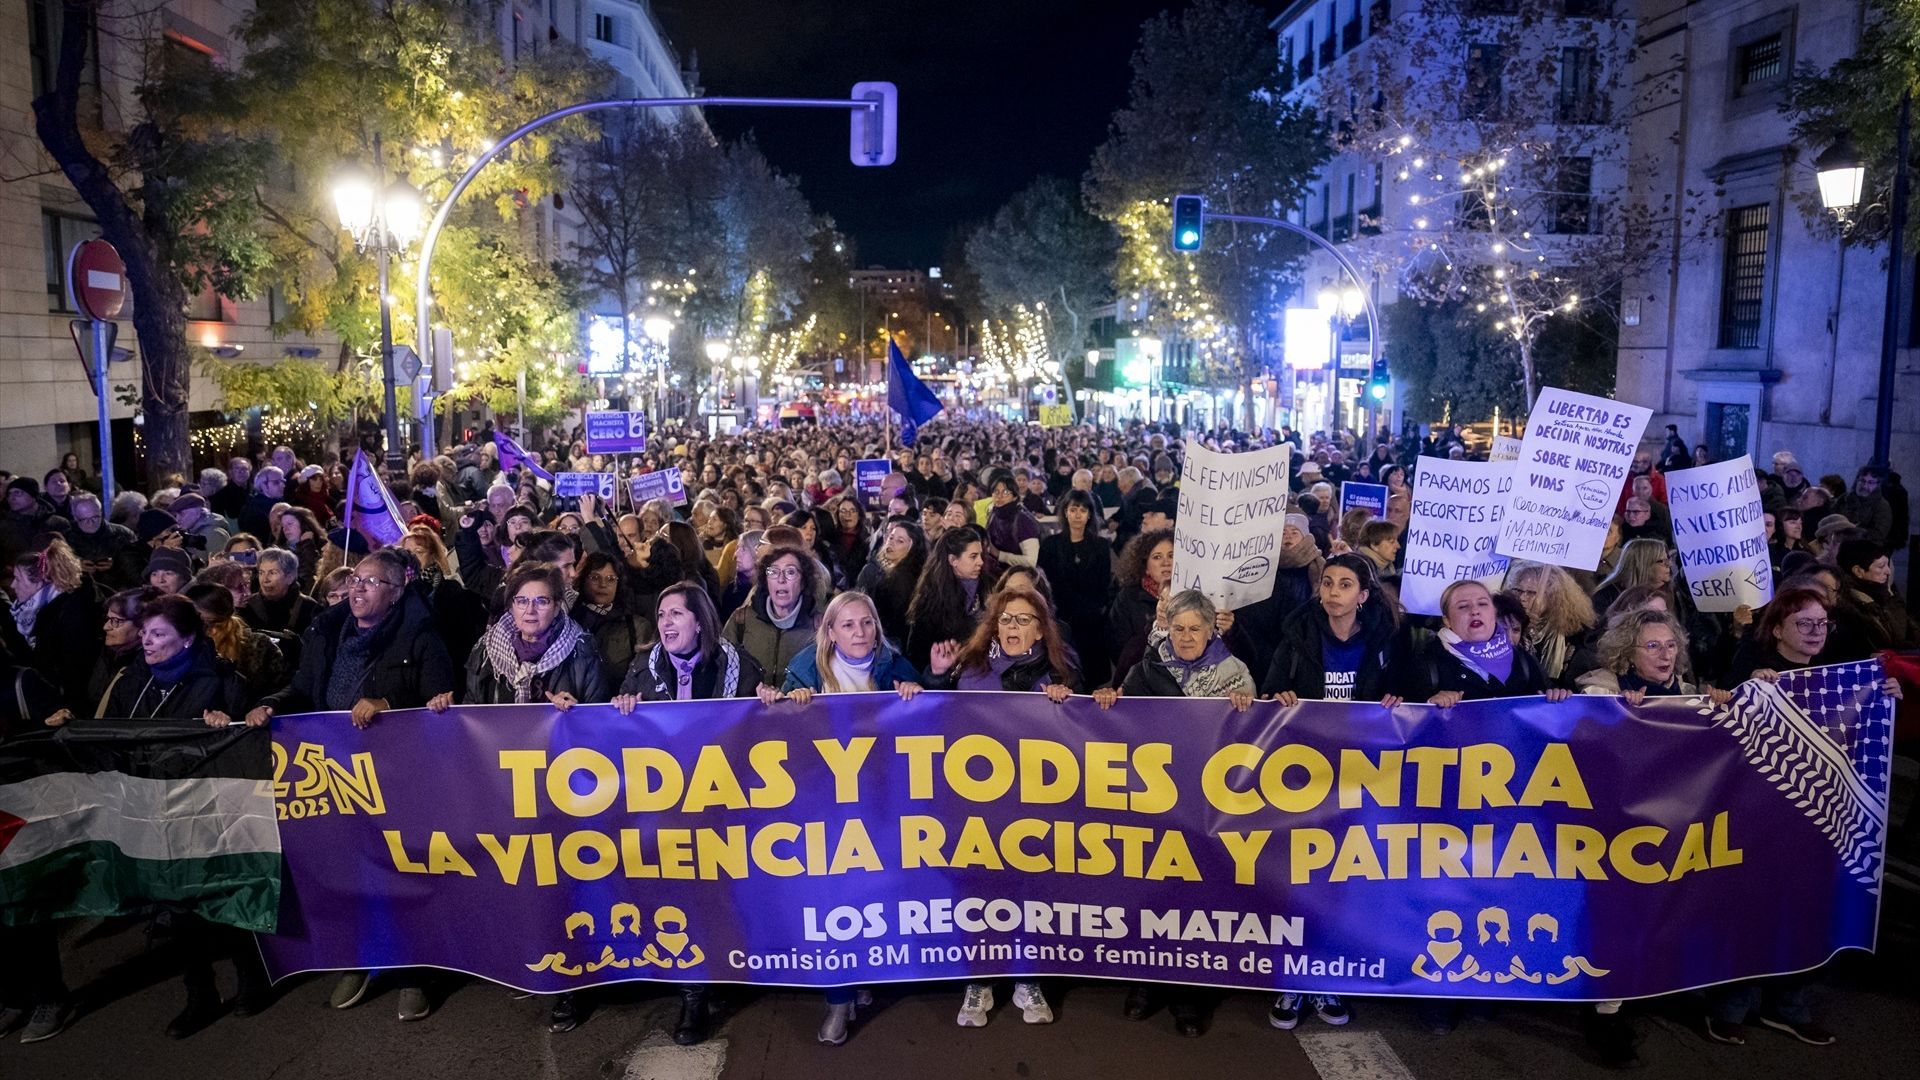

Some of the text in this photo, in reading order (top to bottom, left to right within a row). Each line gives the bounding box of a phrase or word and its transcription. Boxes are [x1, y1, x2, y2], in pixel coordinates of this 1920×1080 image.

[1548, 400, 1631, 429] LIBERTAD ES
[589, 428, 625, 440] CERO
[1535, 424, 1634, 456] DECIDIR NOSOTRAS
[1183, 456, 1286, 491] EL FEMINISMO
[1532, 449, 1624, 480] SOBRE NUESTRAS
[633, 487, 666, 502] CERO
[1419, 471, 1490, 495] PARAMOS
[1529, 473, 1565, 492] VIDAS
[1178, 493, 1194, 517] EN
[1200, 504, 1219, 526] EL
[1413, 500, 1486, 523] RECORTES
[1674, 518, 1687, 536] A
[1175, 527, 1274, 561] AYUSO Y ALMEIDA
[1407, 529, 1498, 552] MADRID CON
[1512, 538, 1570, 559] FEMINISTA!
[1680, 544, 1739, 567] MADRID
[1173, 562, 1180, 584] A
[1184, 570, 1202, 592] LA
[1403, 557, 1508, 581] LUCHA FEMINISTA
[1691, 571, 1736, 597] SERÁ
[1325, 671, 1357, 684] DICAT
[499, 734, 1594, 818] TODAS Y TODES CONTRA
[276, 797, 330, 821] 2025
[383, 811, 1743, 887] LA VIOLENCIA RACISTA Y PATRIARCAL
[803, 897, 1305, 947] LOS RECORTES MATAN
[728, 939, 1386, 979] Comisión 8M movimiento feminista de Madrid
